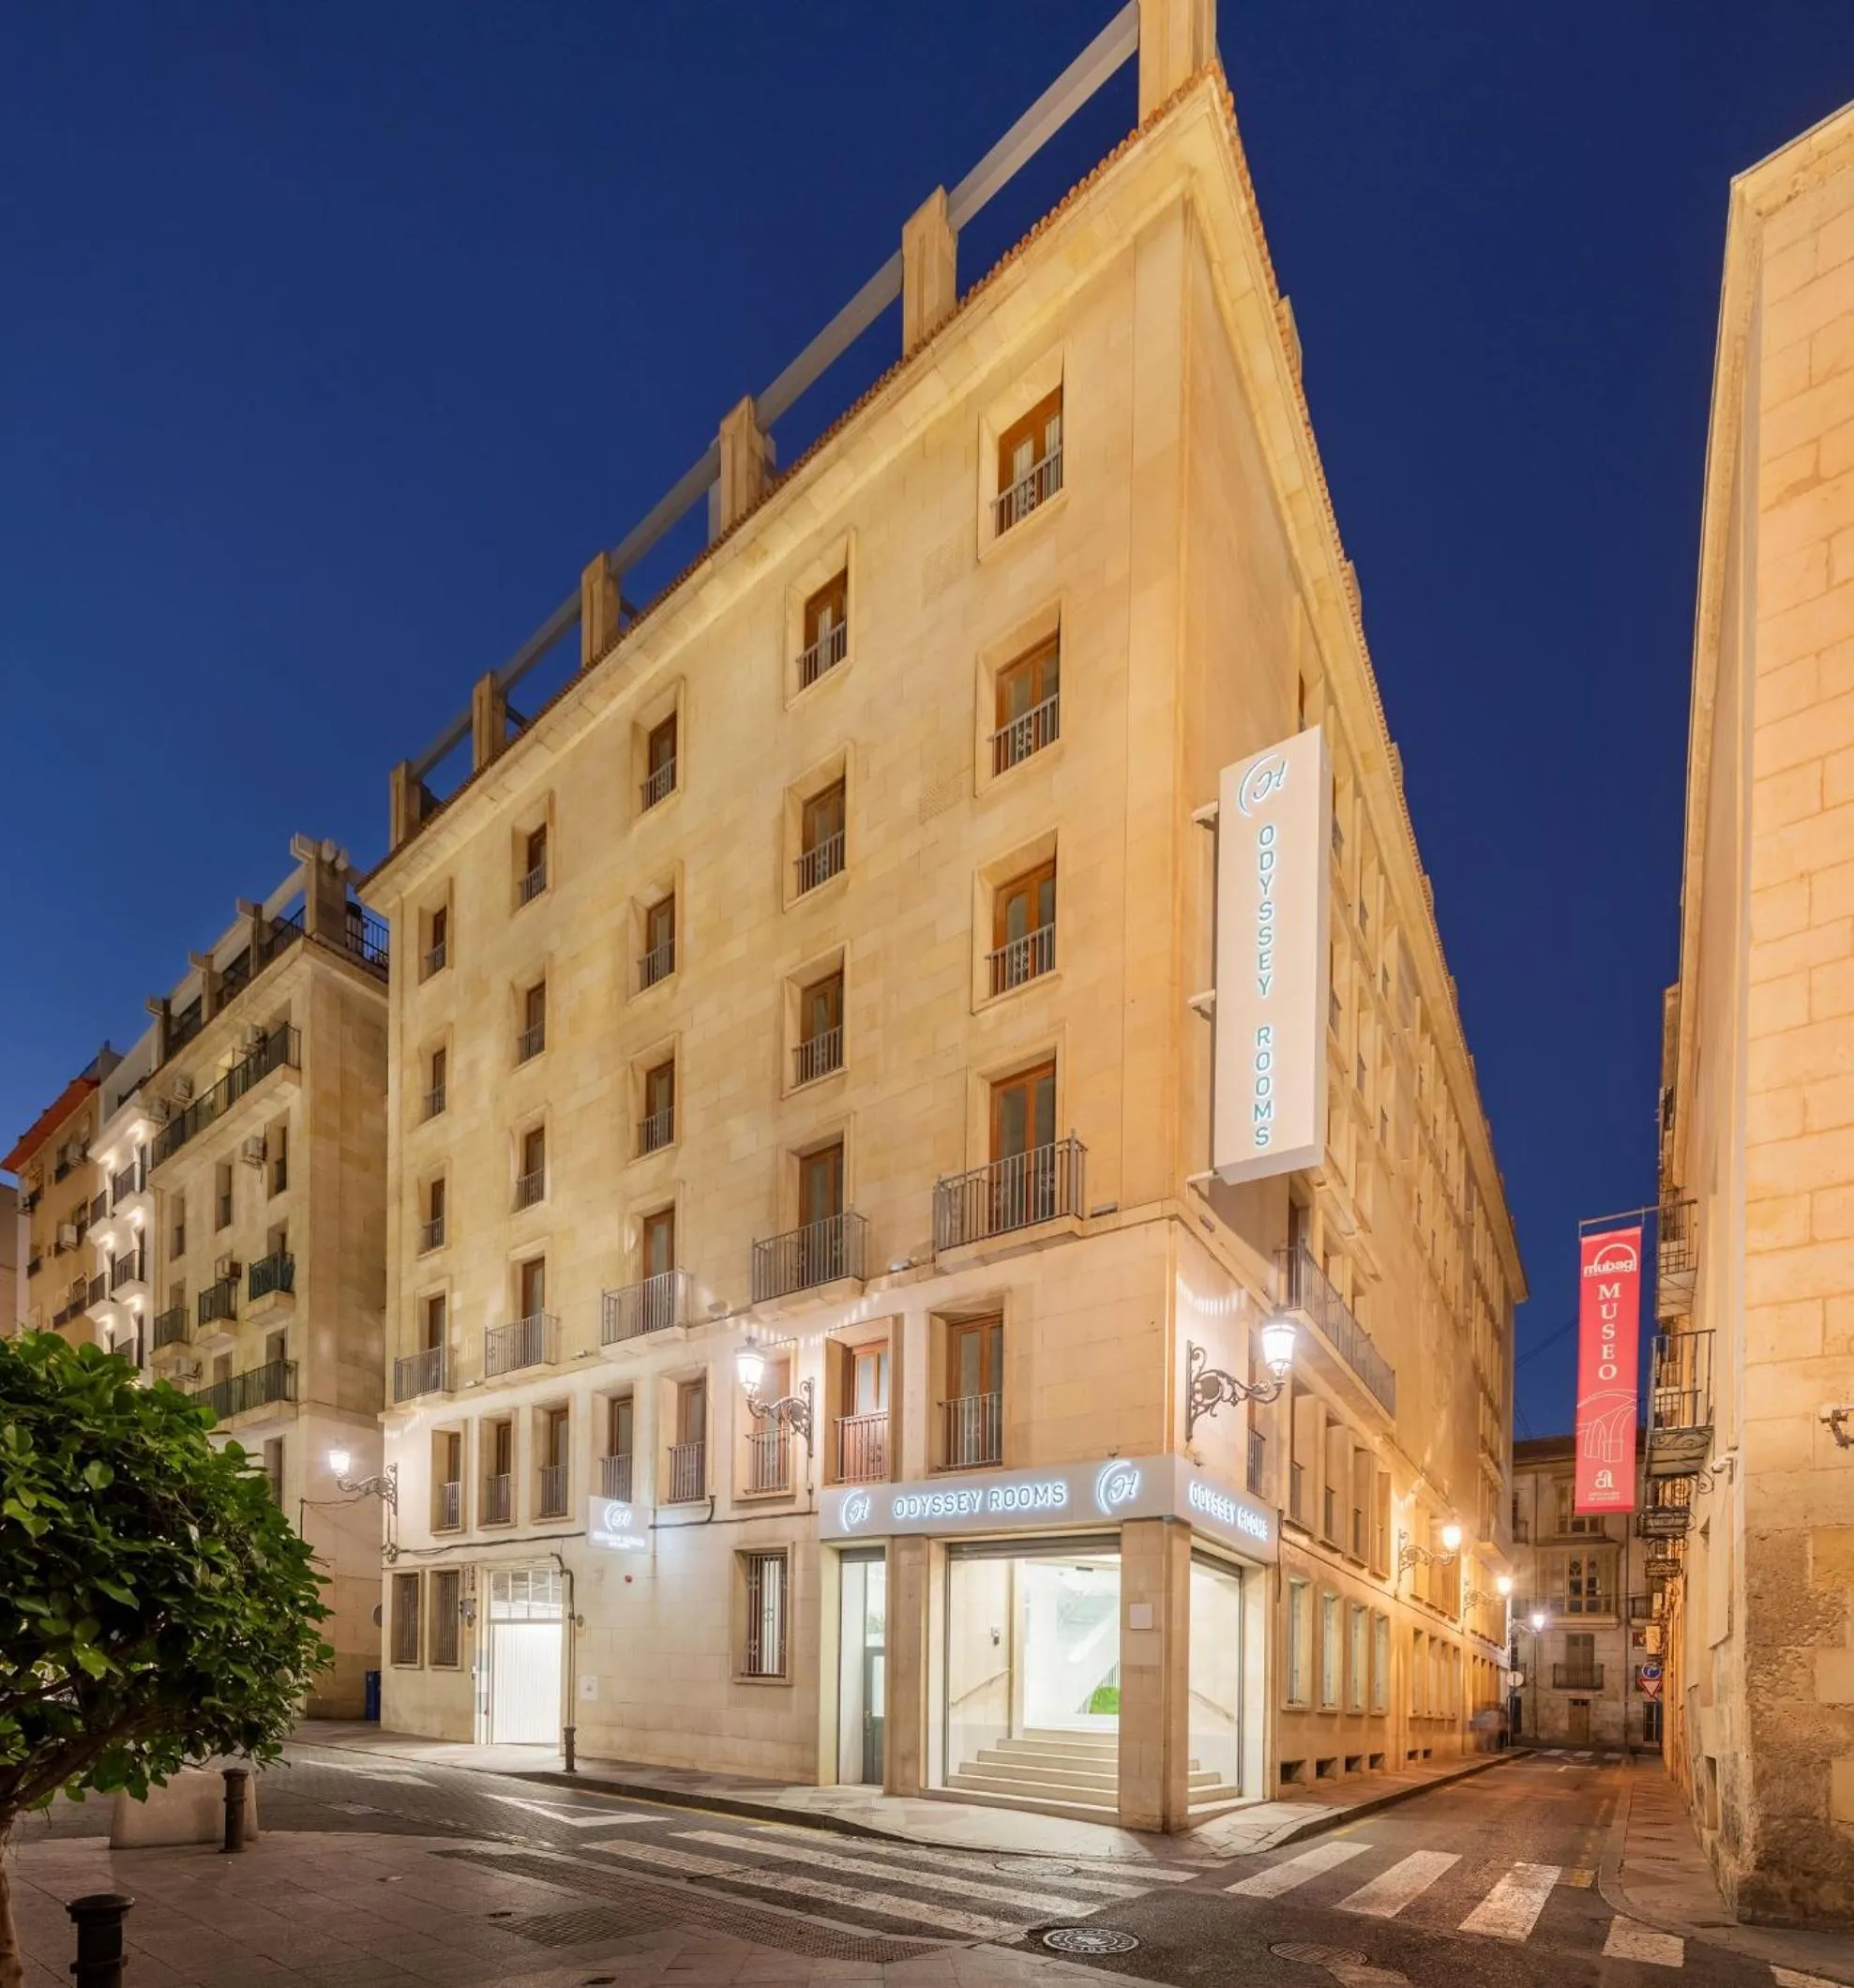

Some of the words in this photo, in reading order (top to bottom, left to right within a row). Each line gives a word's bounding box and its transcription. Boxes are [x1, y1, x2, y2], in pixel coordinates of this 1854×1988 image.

[1258, 824, 1275, 996] ODYSSEY
[1254, 1026, 1272, 1146] ROOMS
[1583, 1259, 1637, 1277] mubag
[1597, 1282, 1621, 1381] MUSEO
[893, 1488, 983, 1517] ODYSSEY
[988, 1483, 1066, 1511] ROOMS
[1188, 1481, 1237, 1525] ODYSSEY
